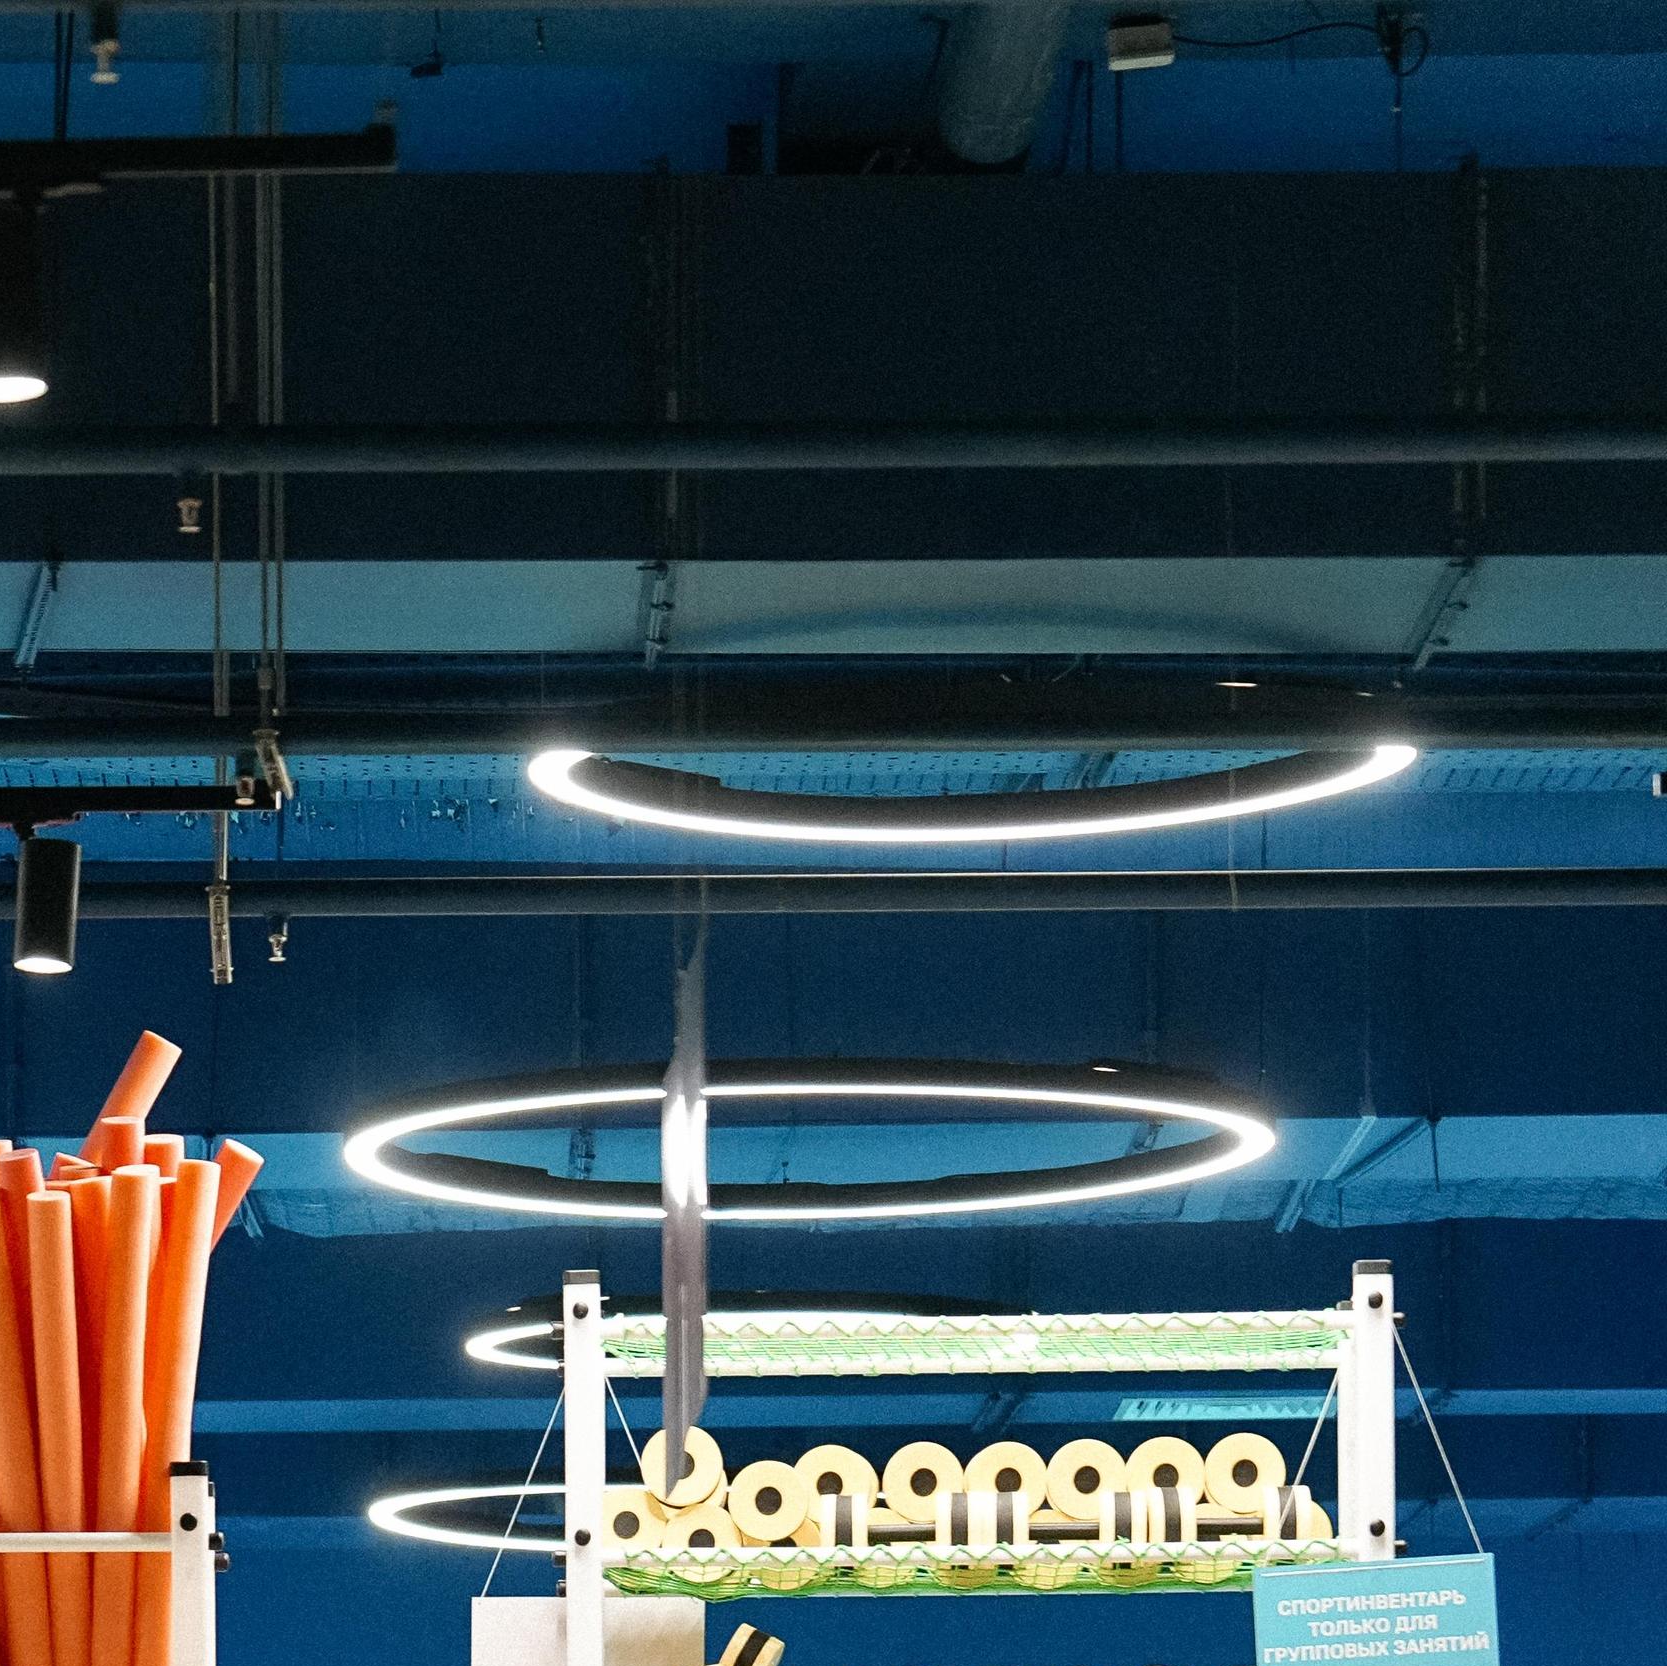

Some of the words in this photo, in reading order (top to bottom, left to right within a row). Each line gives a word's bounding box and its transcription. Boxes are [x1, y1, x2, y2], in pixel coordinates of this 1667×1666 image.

[1277, 1589, 1467, 1616] СПОРТИНВЕНТАРЬ
[1307, 1619, 1391, 1638] ТОЛЬКО
[1394, 1614, 1438, 1633] ДЛЯ
[1263, 1643, 1390, 1663] ГРУППОВЫХ
[1393, 1631, 1490, 1656] ЗАНЯТИЙ
